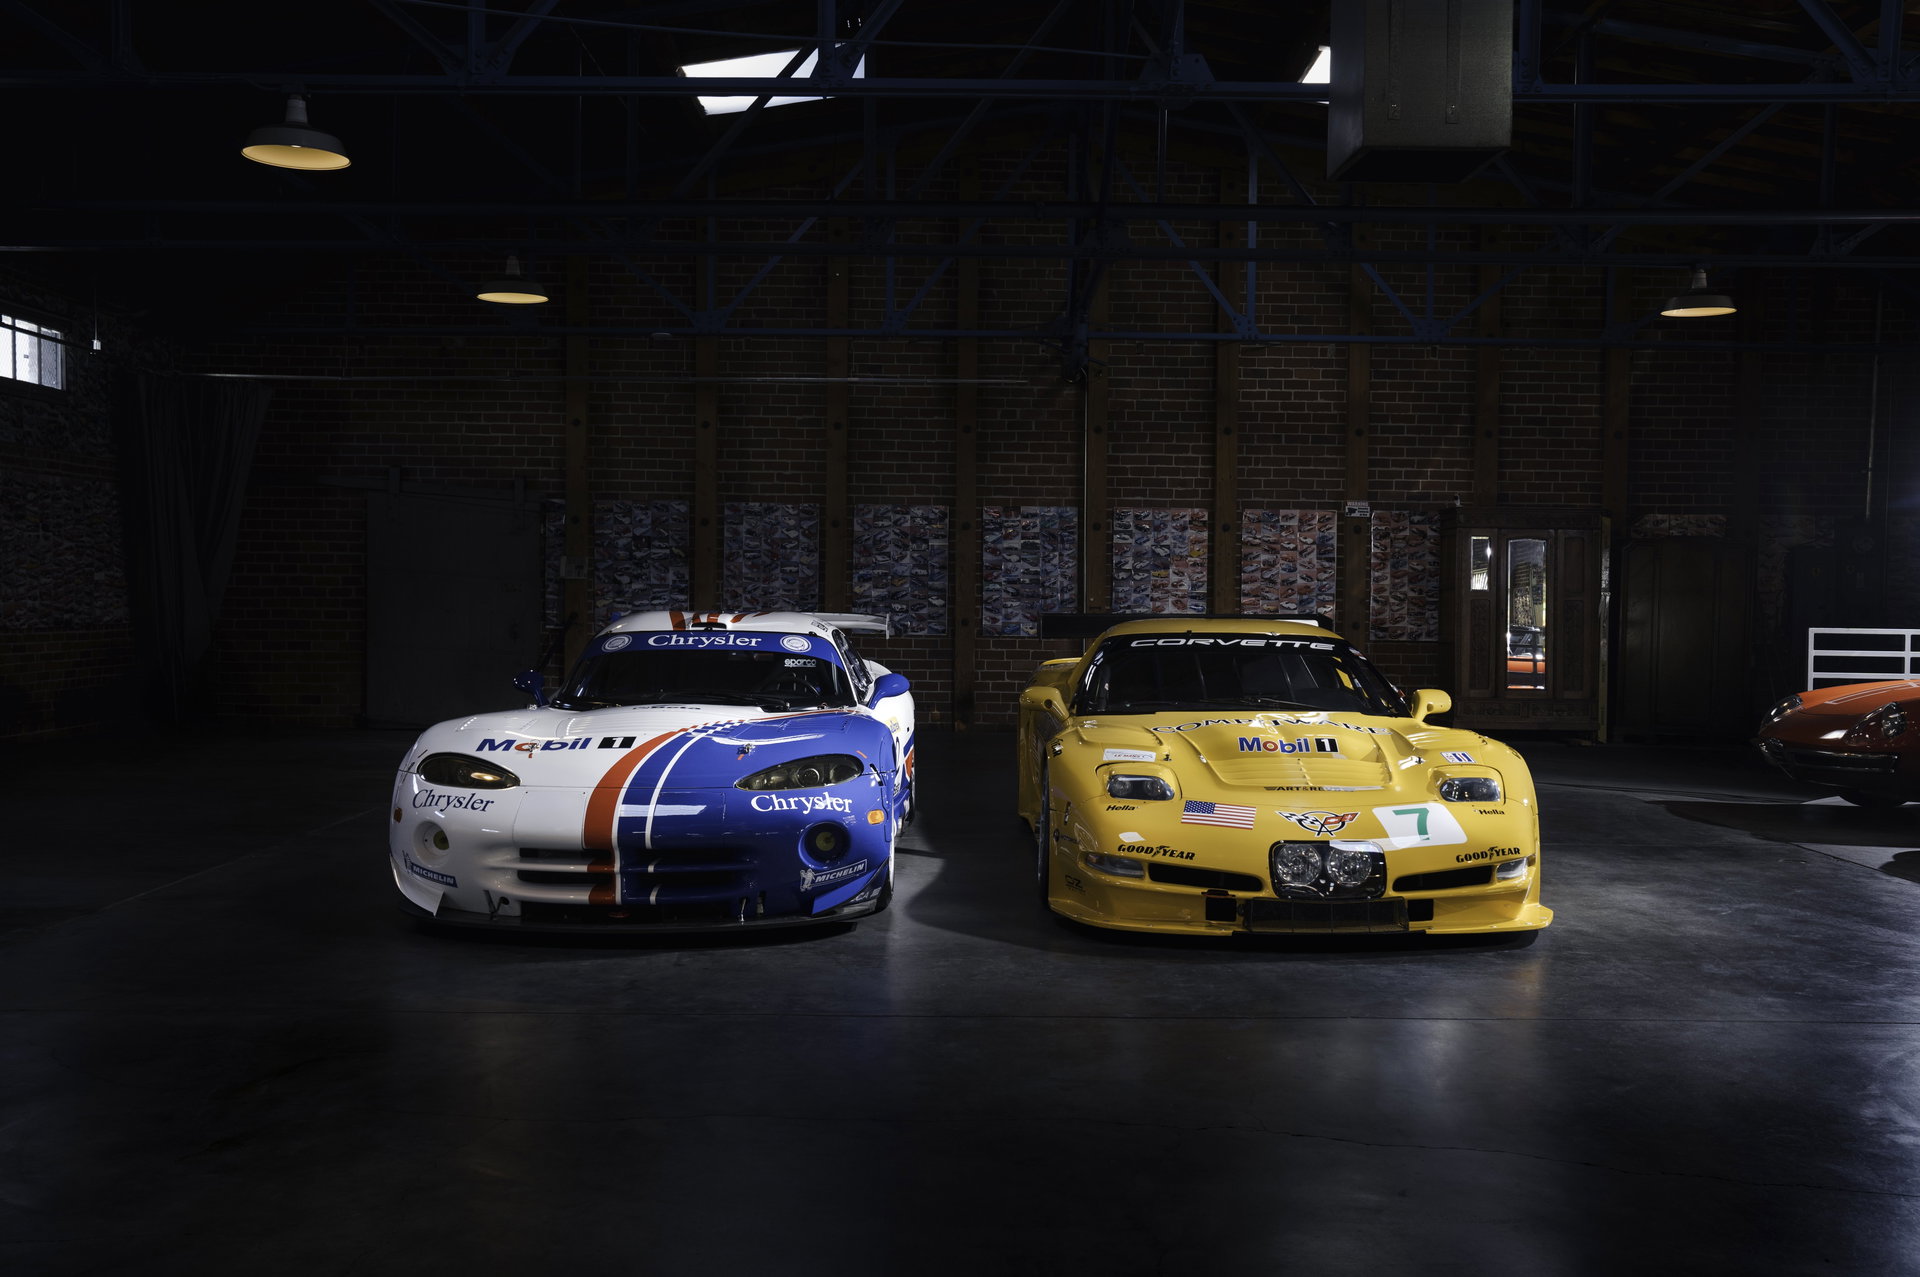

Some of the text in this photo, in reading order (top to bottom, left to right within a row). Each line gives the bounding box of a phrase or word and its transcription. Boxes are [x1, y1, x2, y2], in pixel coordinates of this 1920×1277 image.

[648, 631, 762, 648] Chrysler
[1130, 638, 1335, 651] CORVETTE
[475, 737, 592, 752] Mobil
[1238, 737, 1311, 754] Mobil
[412, 789, 494, 812] Chrysler
[751, 792, 853, 815] Chrysler
[1392, 807, 1430, 841] 7
[1117, 844, 1196, 861] GOODYEAR
[1456, 846, 1521, 863] GOODYEAR
[413, 865, 455, 885] MICHELIN
[815, 863, 865, 883] MICHELIN
